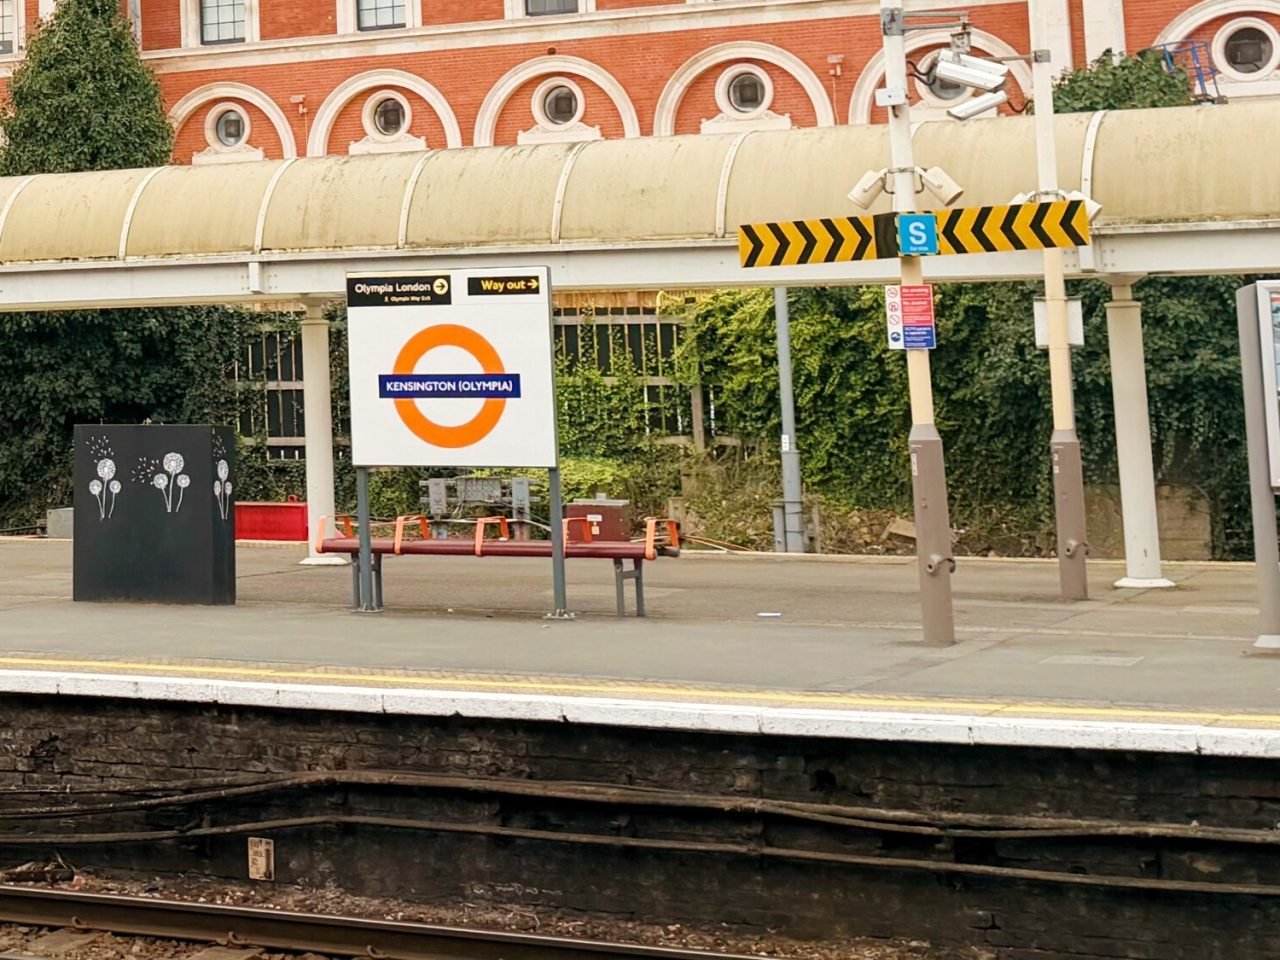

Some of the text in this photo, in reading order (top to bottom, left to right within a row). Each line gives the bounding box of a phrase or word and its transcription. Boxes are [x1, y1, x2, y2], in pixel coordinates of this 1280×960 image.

[908, 221, 927, 245] S
[355, 282, 431, 294] Olympia London
[481, 280, 527, 293] Way out
[386, 380, 513, 392] KENSINGTON (OLYMPIA)
